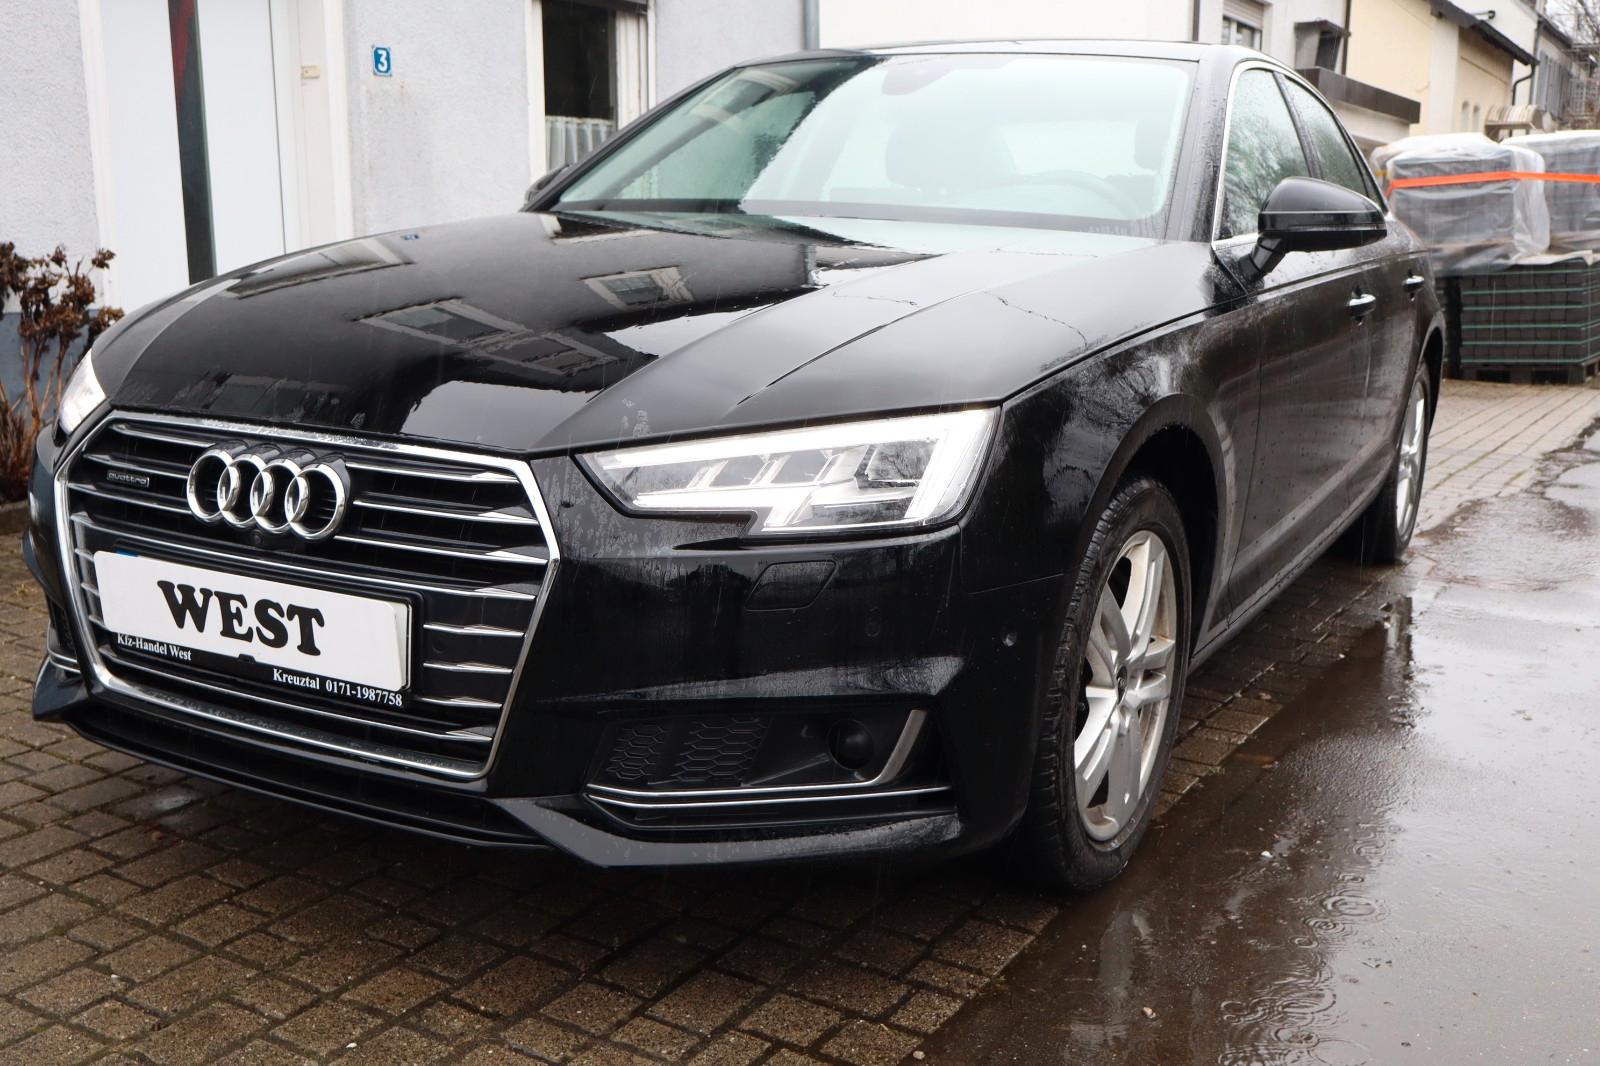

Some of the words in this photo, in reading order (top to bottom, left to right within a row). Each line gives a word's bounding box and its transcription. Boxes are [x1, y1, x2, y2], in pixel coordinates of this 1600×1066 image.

[377, 49, 388, 72] 3
[157, 580, 325, 656] WEST
[117, 633, 167, 655] Kfz-Handel
[169, 644, 192, 661] West
[273, 668, 320, 690] Kreuztal
[325, 679, 403, 707] 0171-1987758
